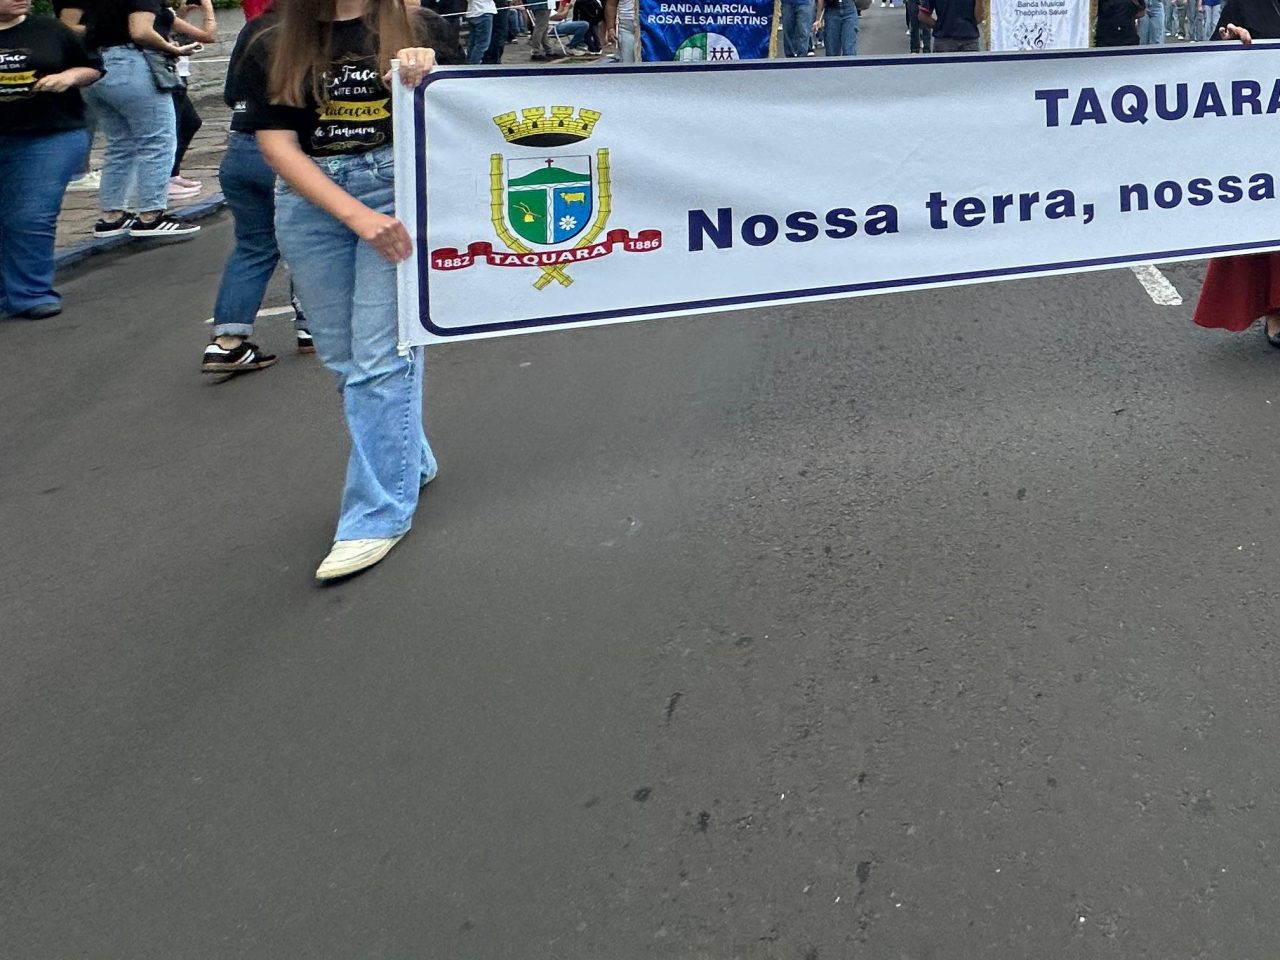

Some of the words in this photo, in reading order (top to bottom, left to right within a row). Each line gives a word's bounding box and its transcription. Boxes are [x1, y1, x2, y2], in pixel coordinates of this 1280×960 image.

[660, 3, 701, 14] BANDA
[704, 3, 756, 14] MARCIAL
[1017, 0, 1039, 8] Banda
[648, 14, 682, 25] ROSA
[684, 15, 714, 25] ELSA
[717, 15, 768, 25] MERTINS
[353, 86, 367, 95] DA
[327, 125, 376, 138] Taquara
[687, 204, 900, 252] Nossa
[925, 188, 1096, 230] terra,
[1119, 169, 1276, 212] nossa
[435, 255, 470, 268] 1882
[491, 246, 607, 265] TAQUARA
[628, 239, 660, 250] 1886
